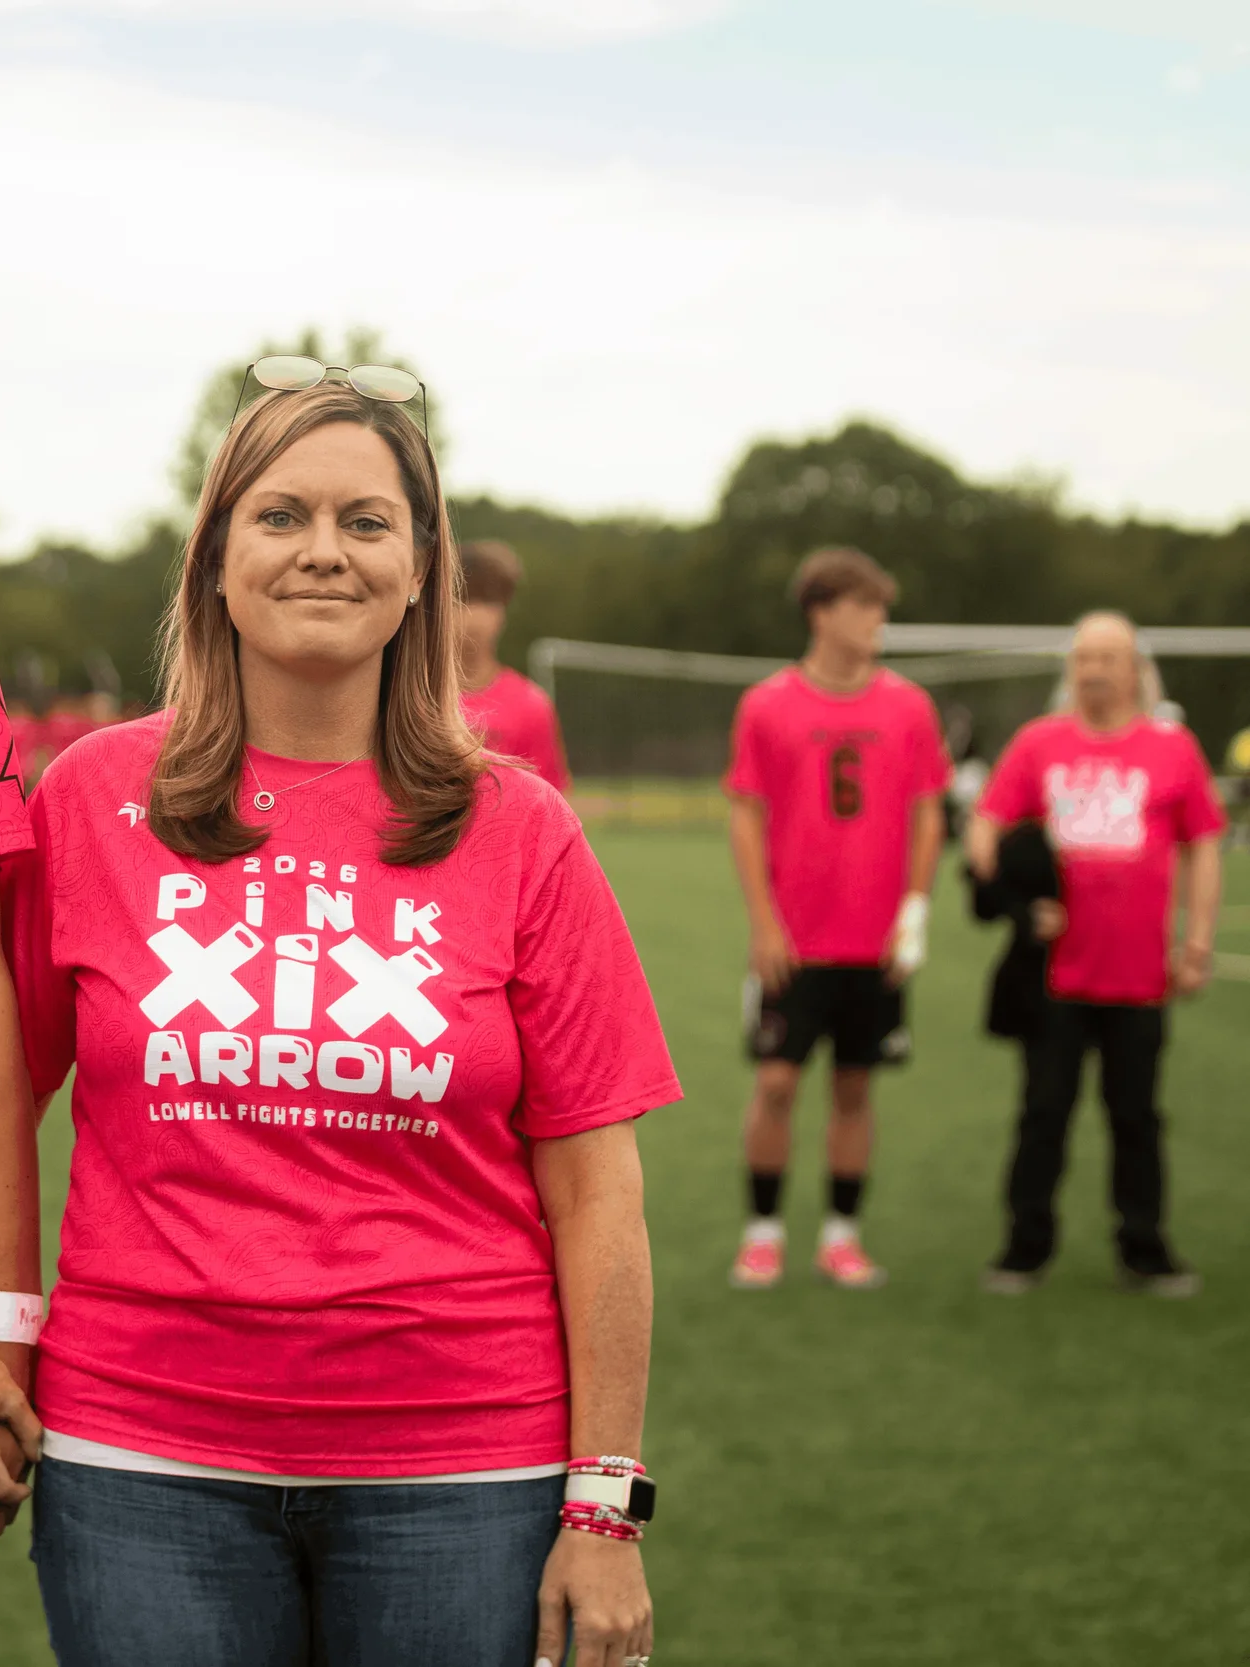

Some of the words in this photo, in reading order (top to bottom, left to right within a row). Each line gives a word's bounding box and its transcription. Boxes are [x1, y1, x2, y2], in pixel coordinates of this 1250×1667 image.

[830, 747, 863, 819] 6
[242, 854, 358, 884] 2026
[144, 1030, 455, 1104] ARROW
[149, 1101, 232, 1121] LOWELL
[323, 1108, 440, 1138] TOGETHER
